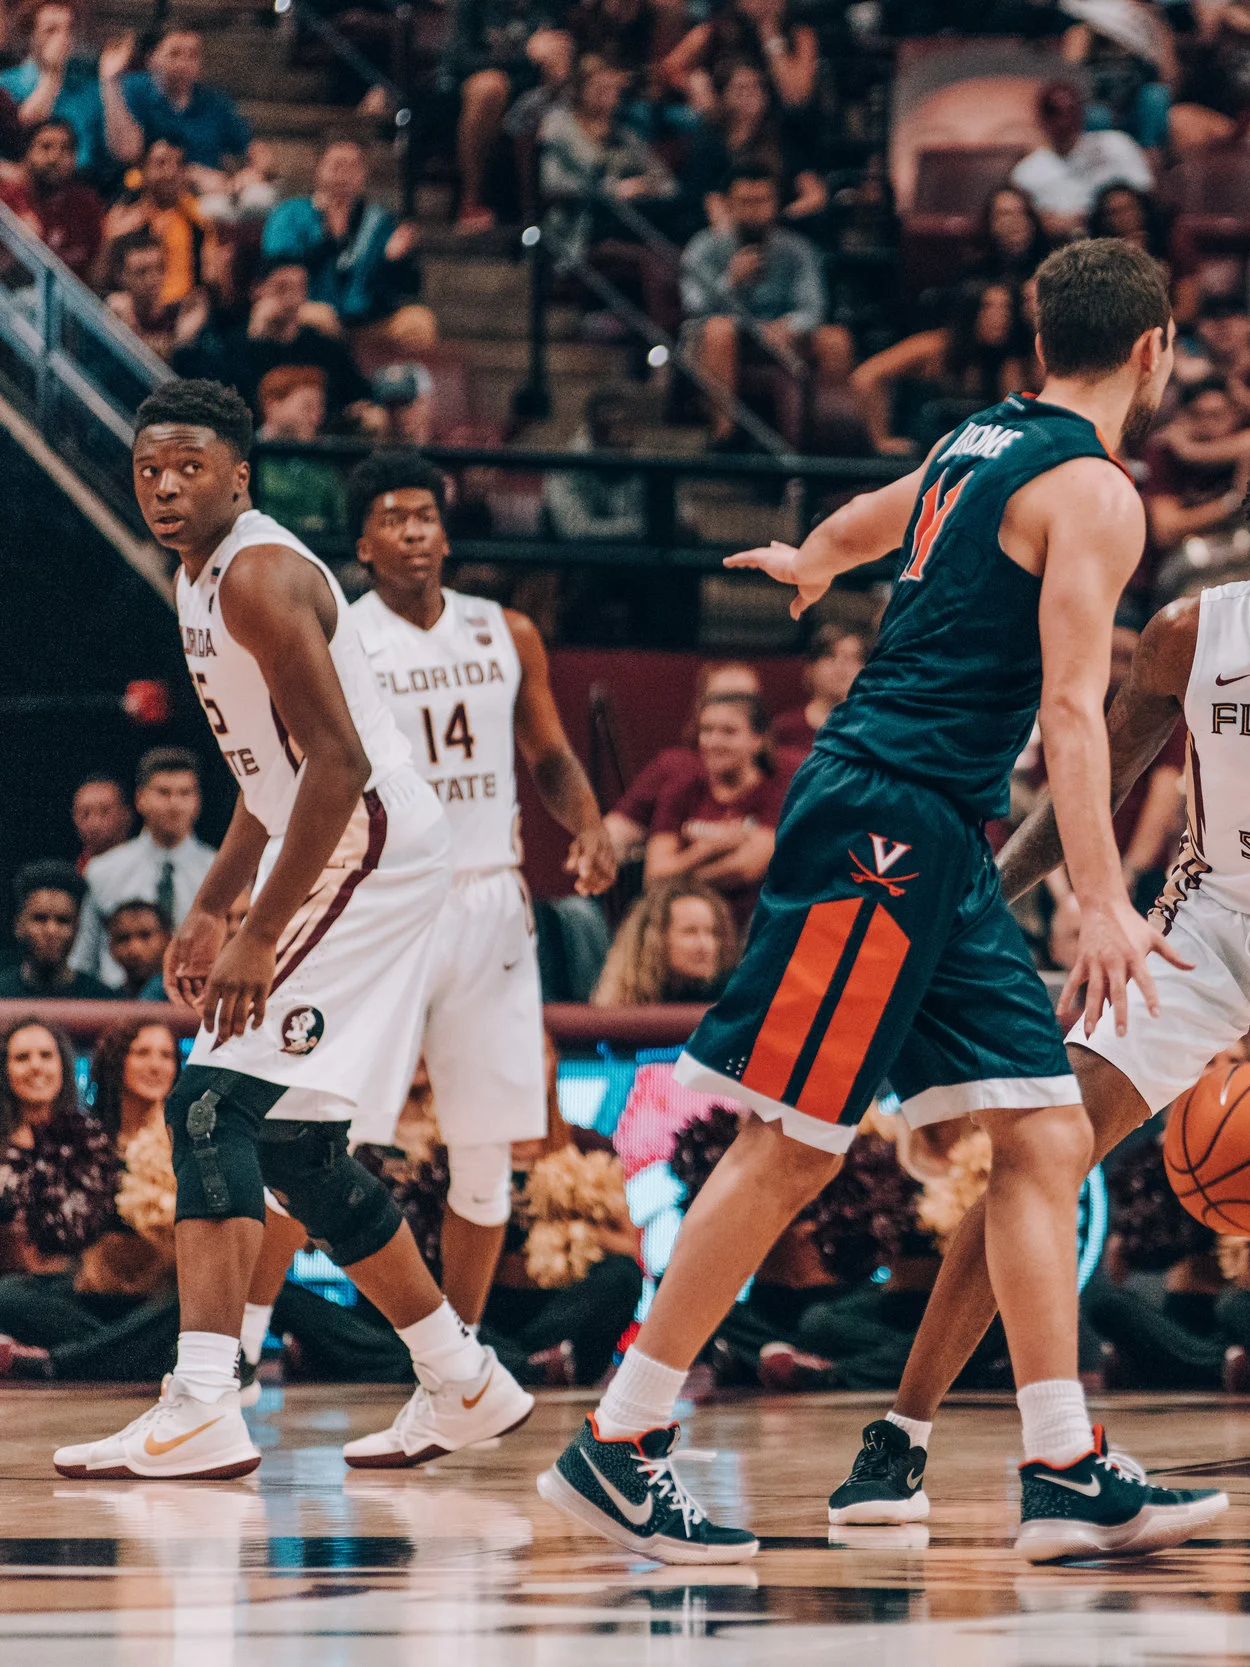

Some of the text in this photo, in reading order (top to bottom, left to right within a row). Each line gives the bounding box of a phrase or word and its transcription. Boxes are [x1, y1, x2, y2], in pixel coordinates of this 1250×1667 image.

[376, 659, 505, 695] FLORIDA
[420, 702, 475, 764] 14
[426, 773, 497, 802] TATE
